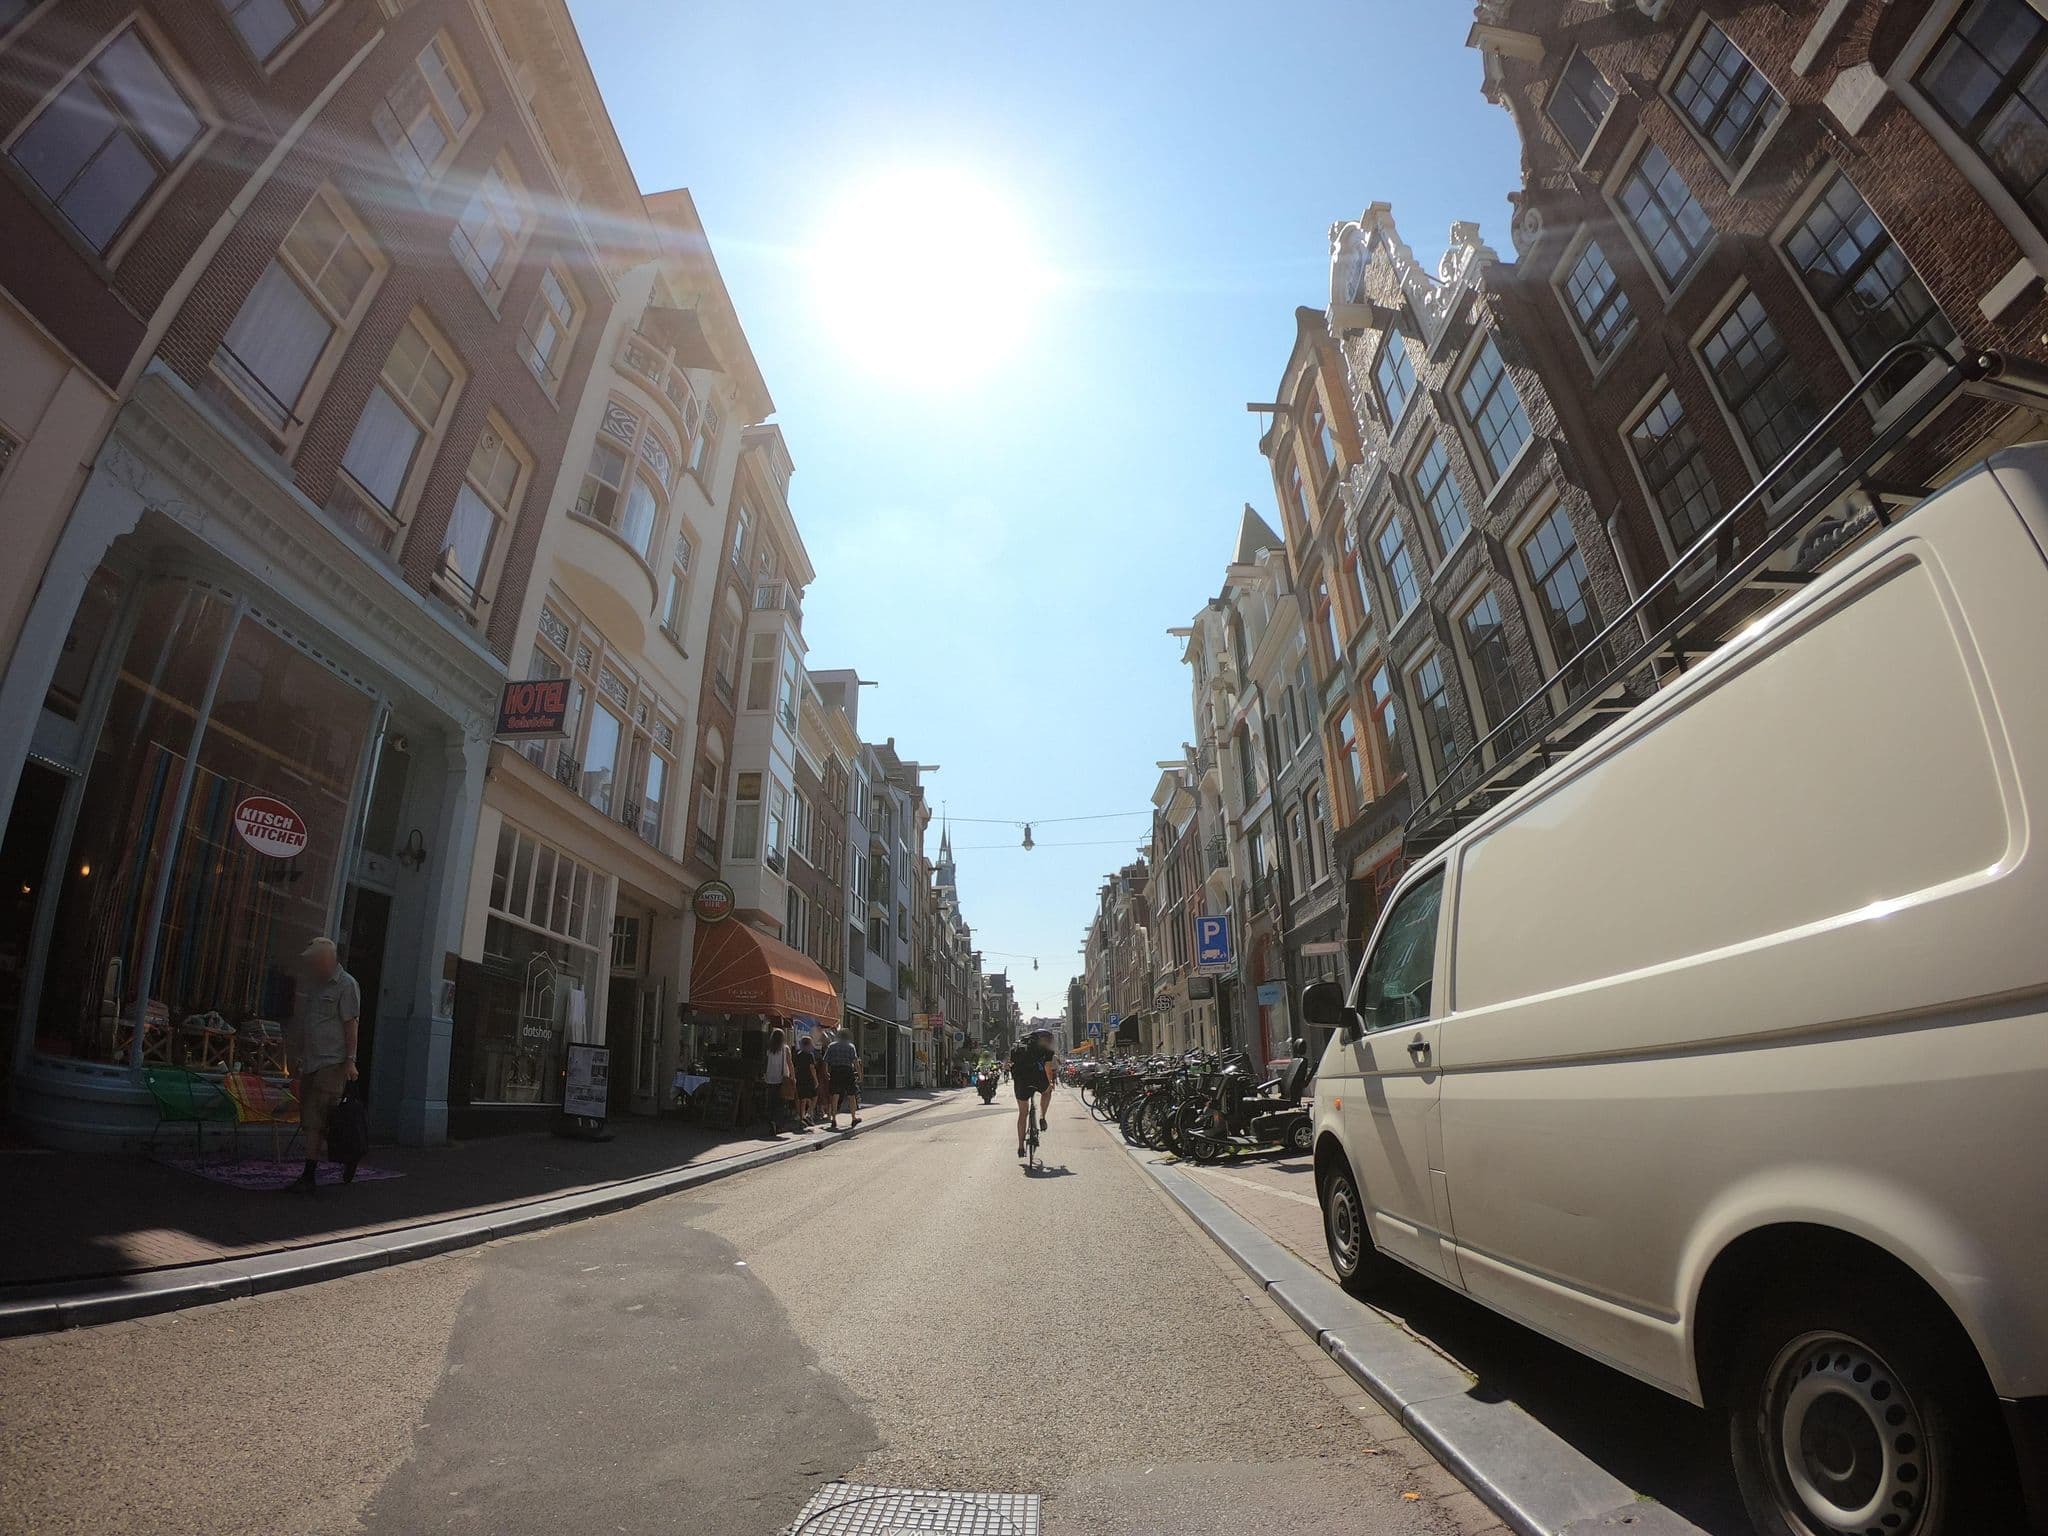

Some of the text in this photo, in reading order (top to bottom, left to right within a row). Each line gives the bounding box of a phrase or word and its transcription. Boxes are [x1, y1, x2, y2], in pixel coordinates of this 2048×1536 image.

[503, 682, 565, 715] HOTEL
[240, 807, 294, 830] KITSCH
[244, 823, 305, 847] KITCHEN
[1203, 921, 1220, 945] P
[1110, 1015, 1117, 1023] P
[522, 1024, 552, 1041] dotshop
